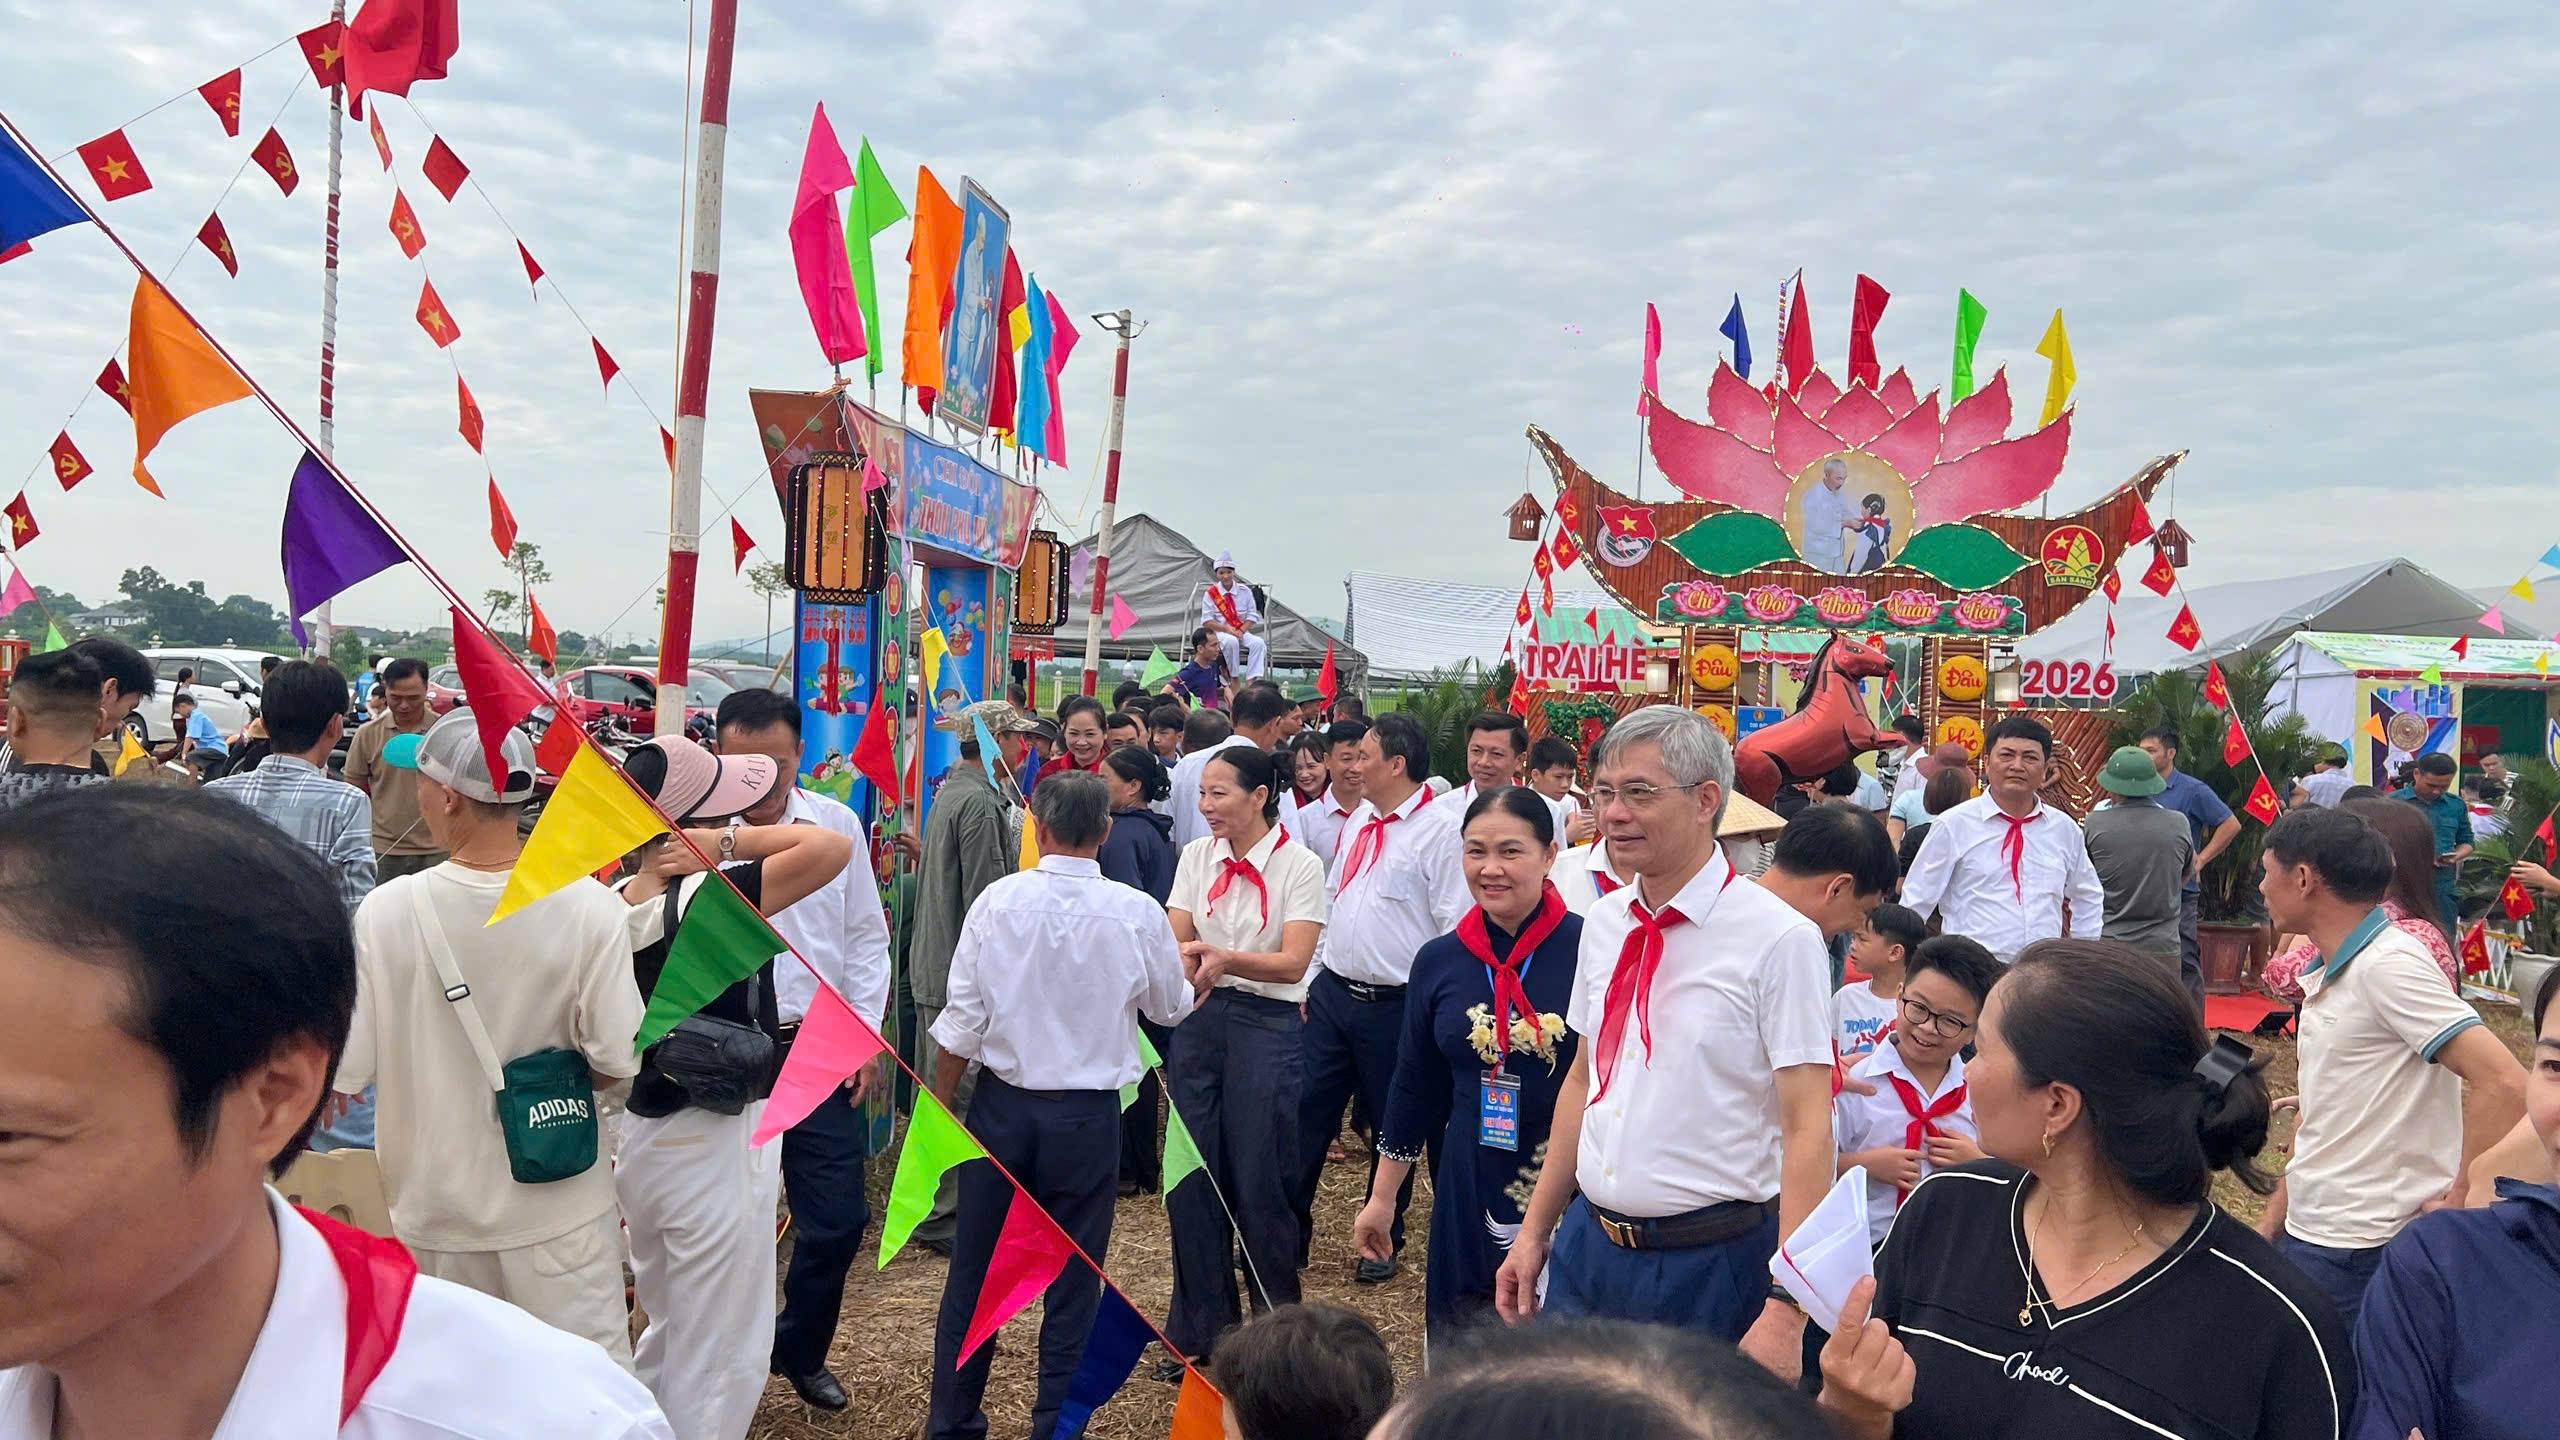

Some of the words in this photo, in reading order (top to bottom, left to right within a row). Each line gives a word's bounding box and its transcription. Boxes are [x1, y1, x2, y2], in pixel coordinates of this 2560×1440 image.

[1687, 590, 1715, 610] Chi
[1524, 645, 1597, 690] TRẠI
[1605, 634, 1647, 681] HÈ
[2022, 660, 2116, 696] 2026
[1844, 1017, 1883, 1034] TODAY
[529, 1098, 589, 1128] ADIDAS
